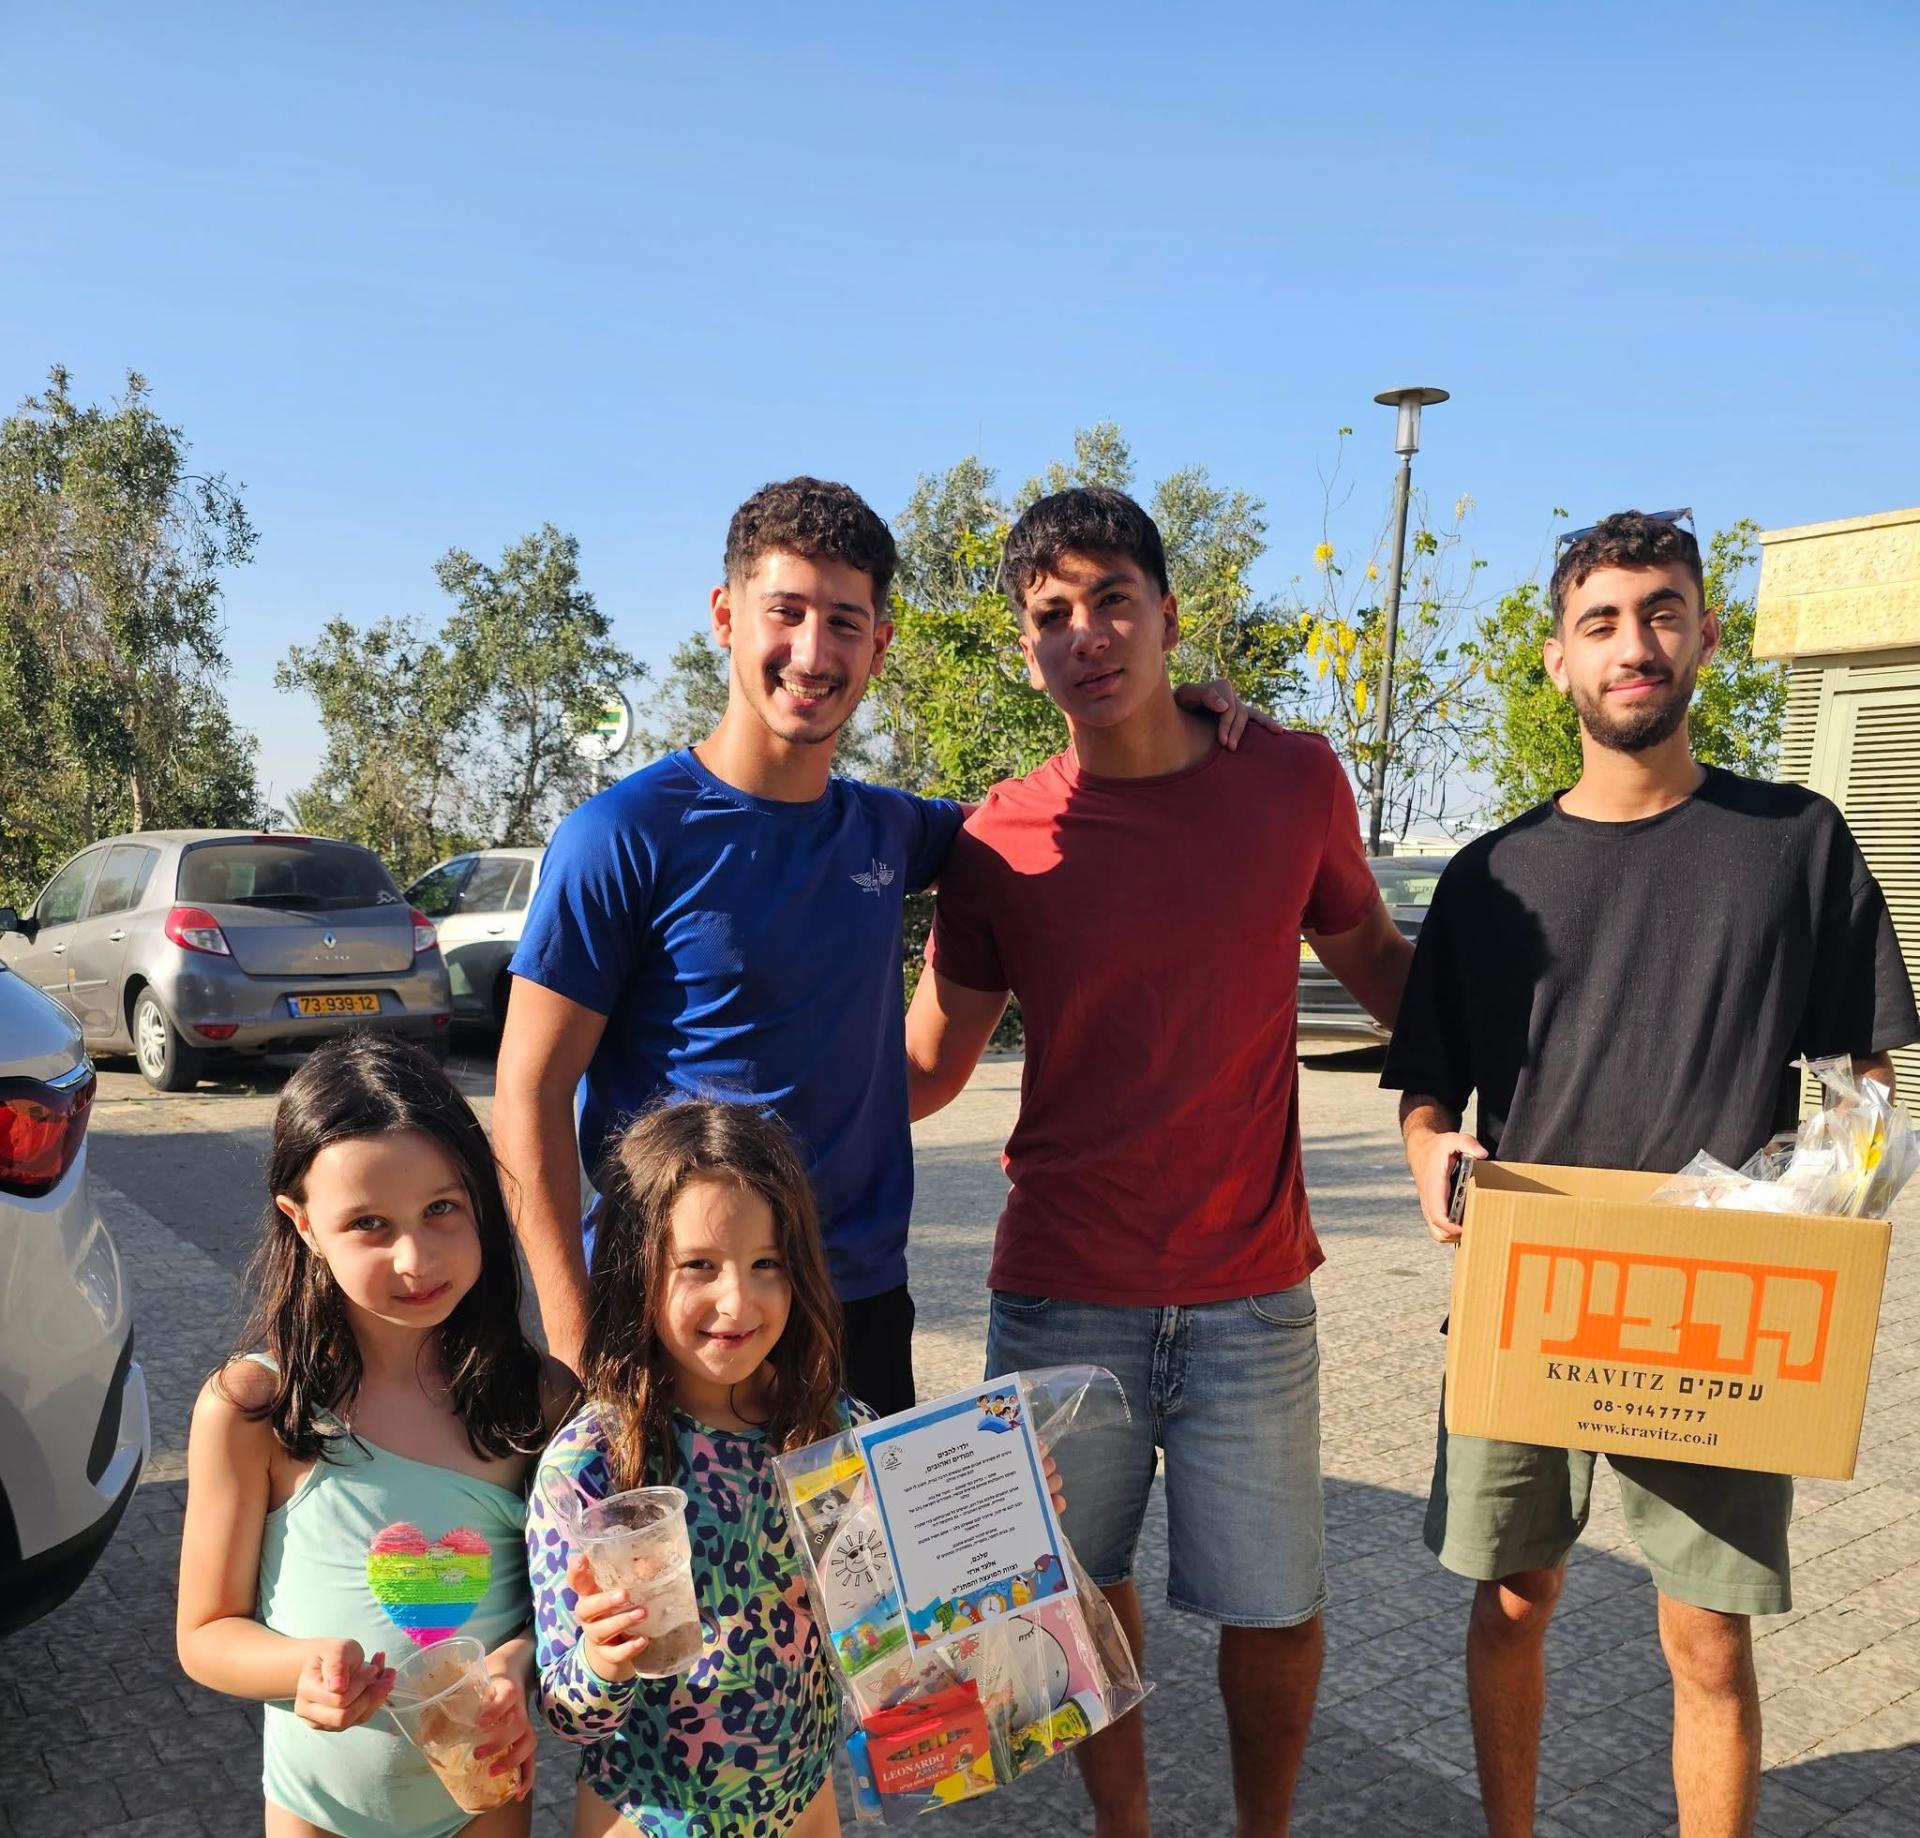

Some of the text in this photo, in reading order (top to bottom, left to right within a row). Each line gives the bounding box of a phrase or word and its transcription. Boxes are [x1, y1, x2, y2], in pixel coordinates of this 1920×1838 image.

[1546, 1362, 1764, 1402] KRAVITZ עסקים
[1593, 1400, 1707, 1424] 08-9147777
[1577, 1419, 1718, 1447] www.kravitz.co.il
[883, 1753, 945, 1782] LEONARDO
